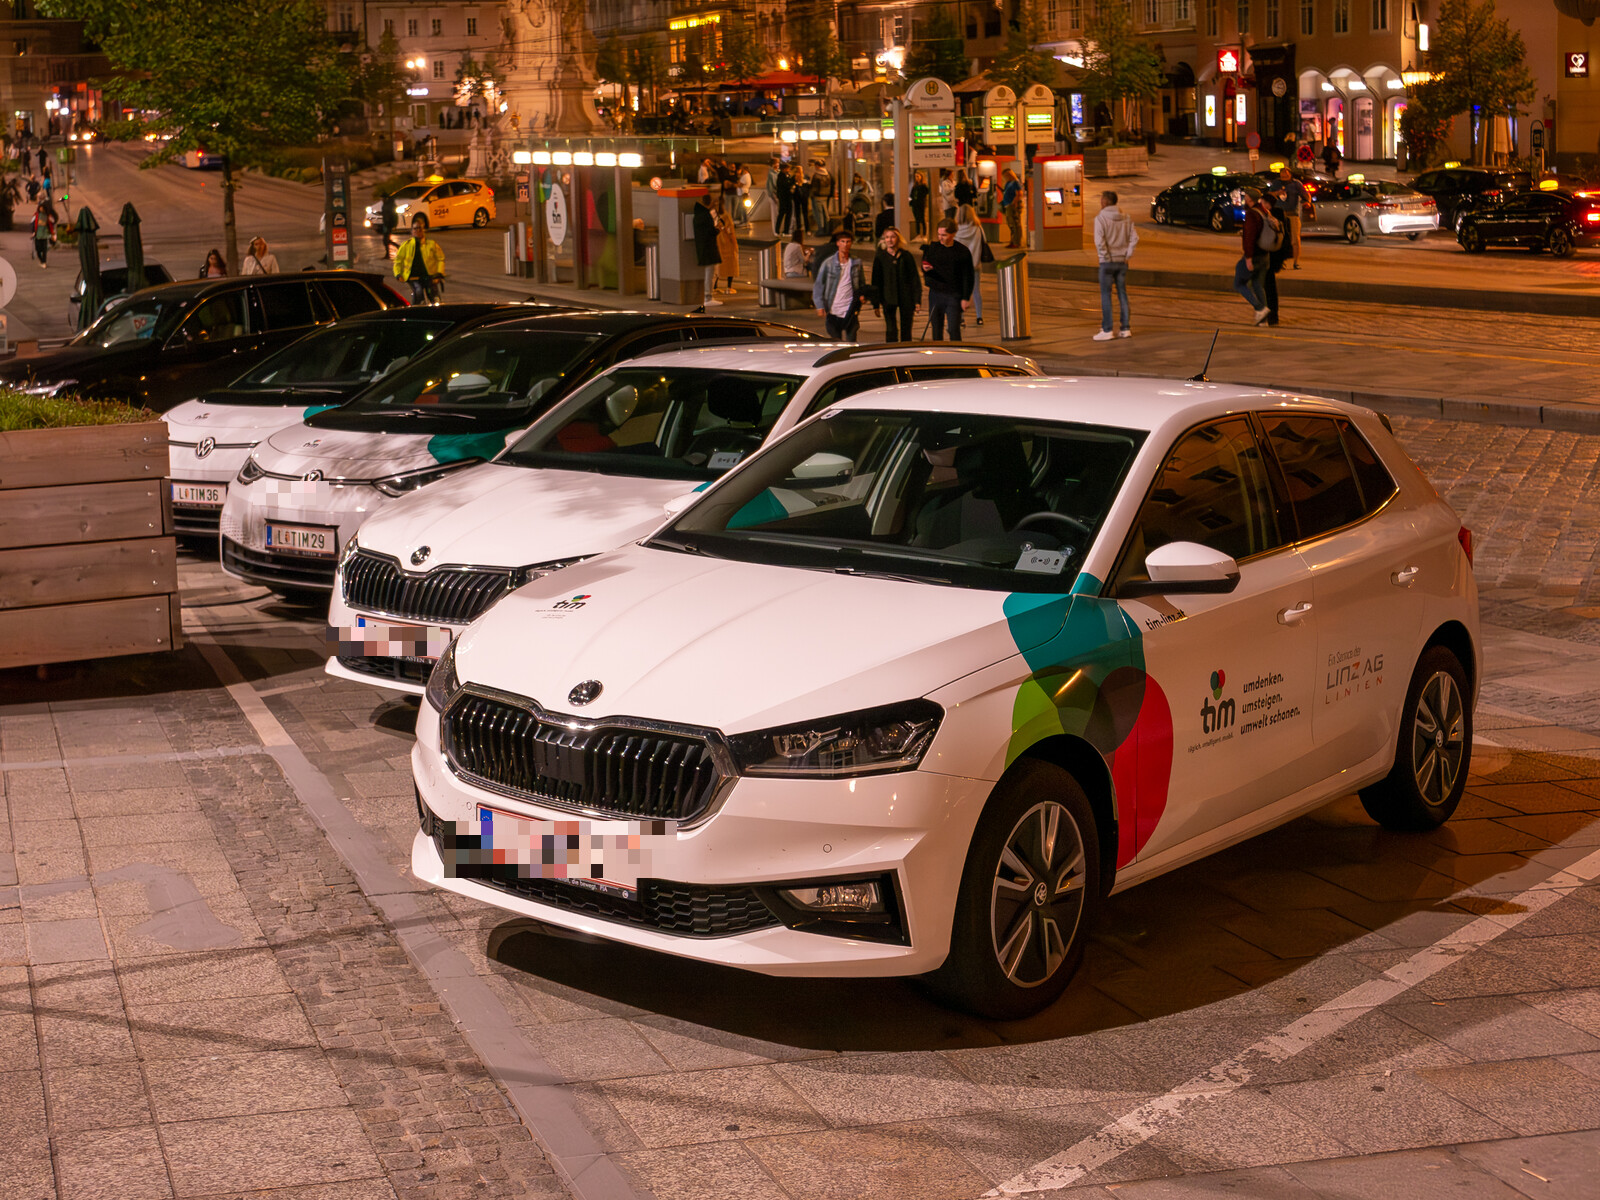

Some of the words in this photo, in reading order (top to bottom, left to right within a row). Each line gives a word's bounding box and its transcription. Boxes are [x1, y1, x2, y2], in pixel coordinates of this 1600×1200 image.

[552, 599, 586, 610] tim
[1243, 672, 1284, 694] umdenken.
[1325, 675, 1384, 705] LINIEN
[1200, 697, 1236, 735] tim
[1242, 693, 1283, 714] umsteigen.
[1240, 714, 1268, 735] umwelt
[1269, 706, 1301, 726] schonen.
